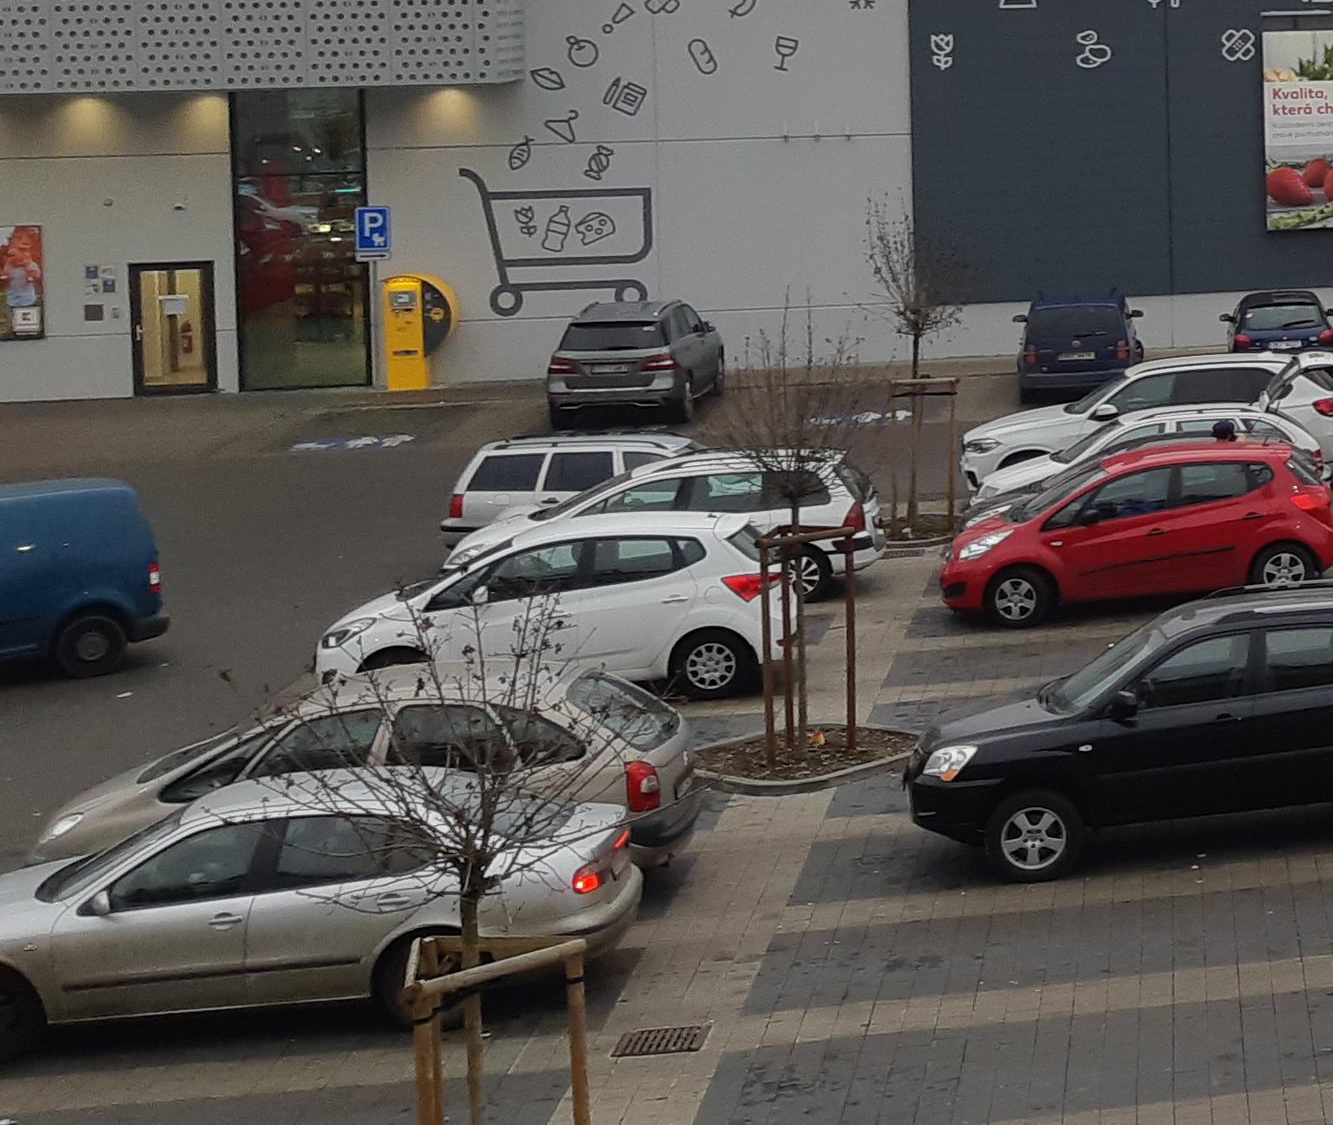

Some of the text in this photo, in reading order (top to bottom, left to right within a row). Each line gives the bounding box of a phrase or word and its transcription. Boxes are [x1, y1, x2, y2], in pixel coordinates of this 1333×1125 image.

[1272, 86, 1328, 101] Kvalita,
[1272, 103, 1313, 116] která
[363, 212, 384, 237] P
